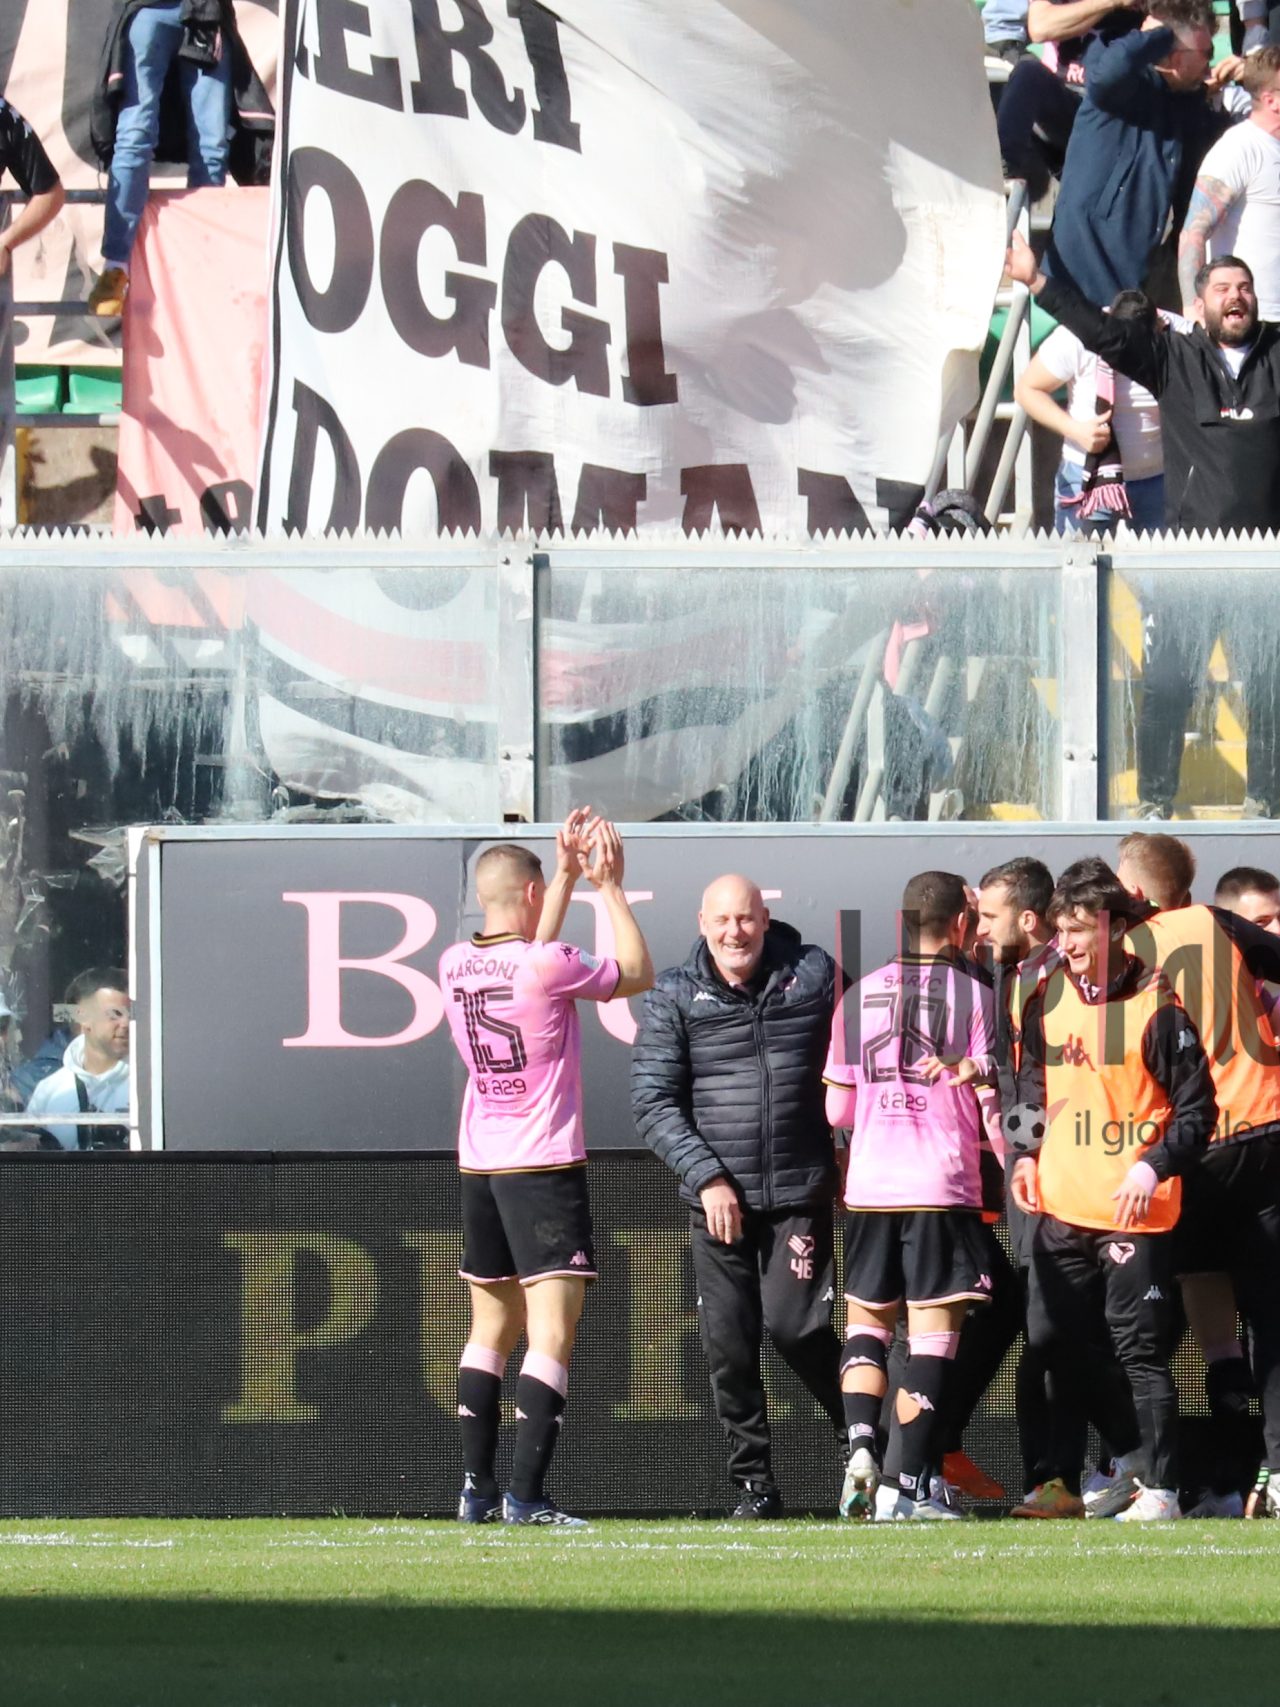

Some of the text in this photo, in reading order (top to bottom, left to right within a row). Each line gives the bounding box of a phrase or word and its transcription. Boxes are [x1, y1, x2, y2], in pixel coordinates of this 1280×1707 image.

[293, 0, 583, 153] ERI
[288, 146, 679, 406] OGGI
[446, 959, 520, 983] MARCONI
[453, 986, 528, 1073] 15
[790, 1258, 814, 1279] 46
